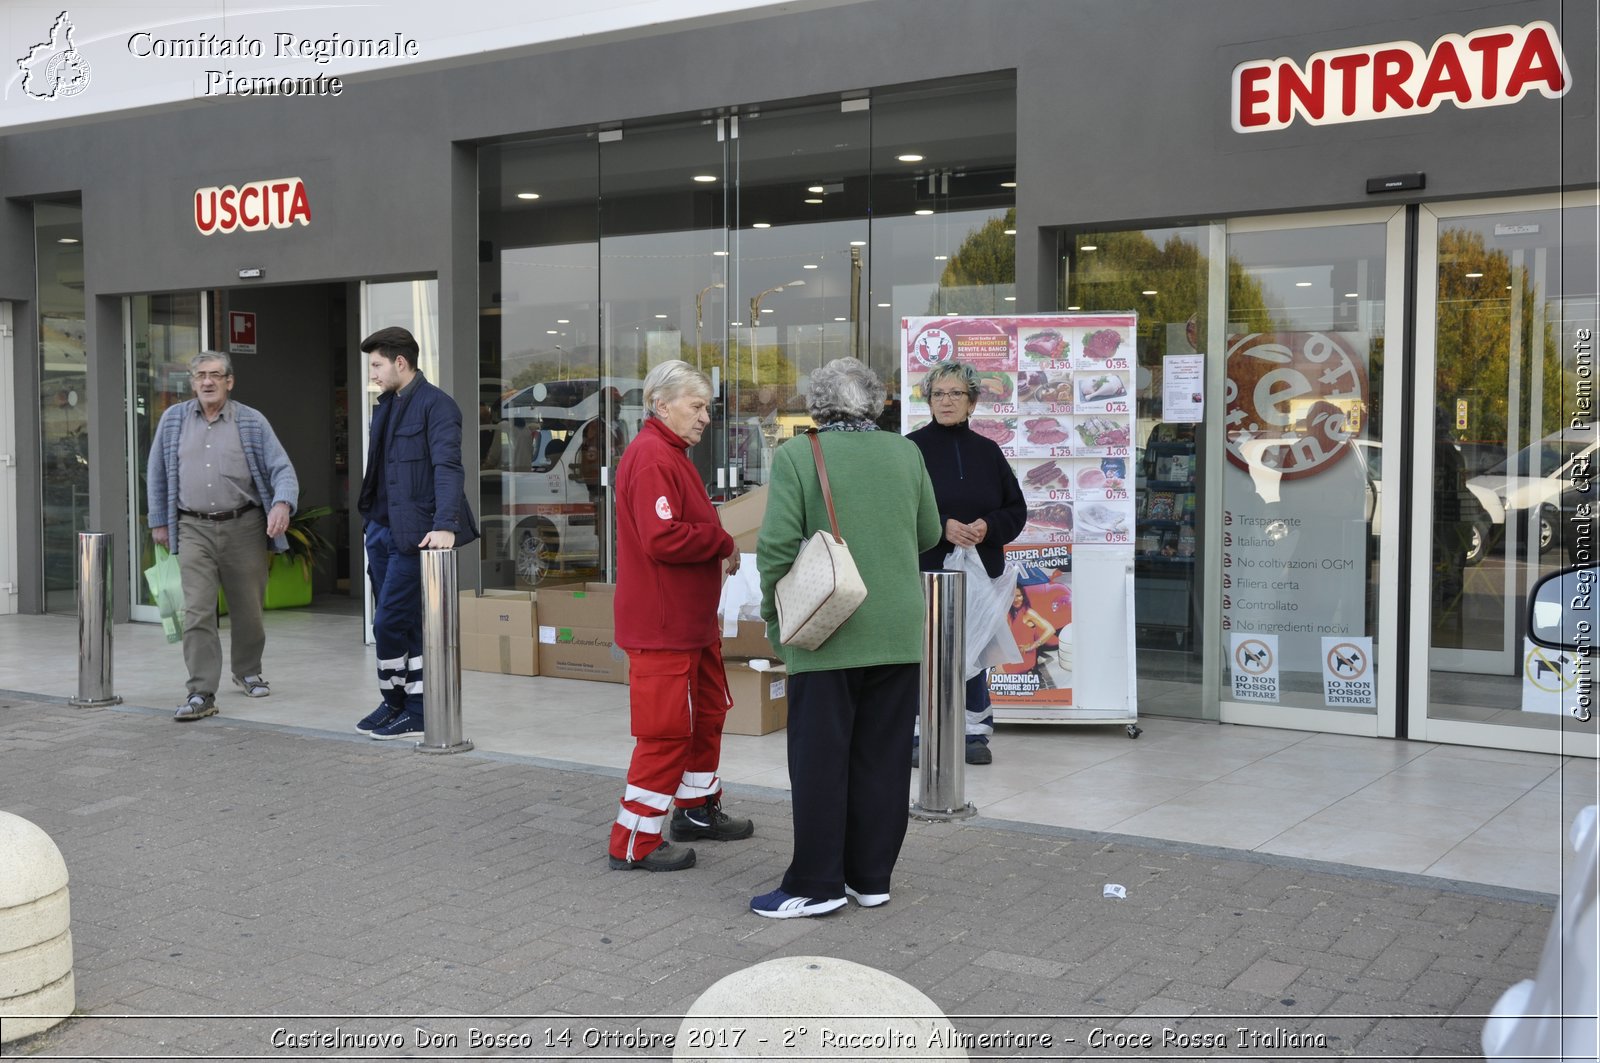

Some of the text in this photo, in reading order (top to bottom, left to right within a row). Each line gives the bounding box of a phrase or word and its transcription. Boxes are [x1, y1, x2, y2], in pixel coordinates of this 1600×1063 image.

[1240, 28, 1565, 127] ENTRATA
[196, 181, 311, 231] USCITA
[1237, 515, 1301, 527] Trasparente
[1237, 536, 1275, 547] Italiano
[1006, 546, 1068, 561] SUPER CARS
[1025, 558, 1069, 569] MAGNONE
[1237, 557, 1354, 570] No coltivazioni OGM
[1237, 578, 1299, 590] Filiera certa
[1236, 599, 1298, 611] Controllato
[1236, 621, 1349, 634] No ingredienti nocivi
[991, 674, 1040, 684] DOMENICA
[1235, 675, 1276, 684] IO NON
[1236, 682, 1276, 691] POSSO
[1345, 681, 1371, 689] NON
[1235, 690, 1276, 699] ENTRARE
[1328, 688, 1371, 696] POSSO
[1328, 696, 1371, 704] ENTRARE
